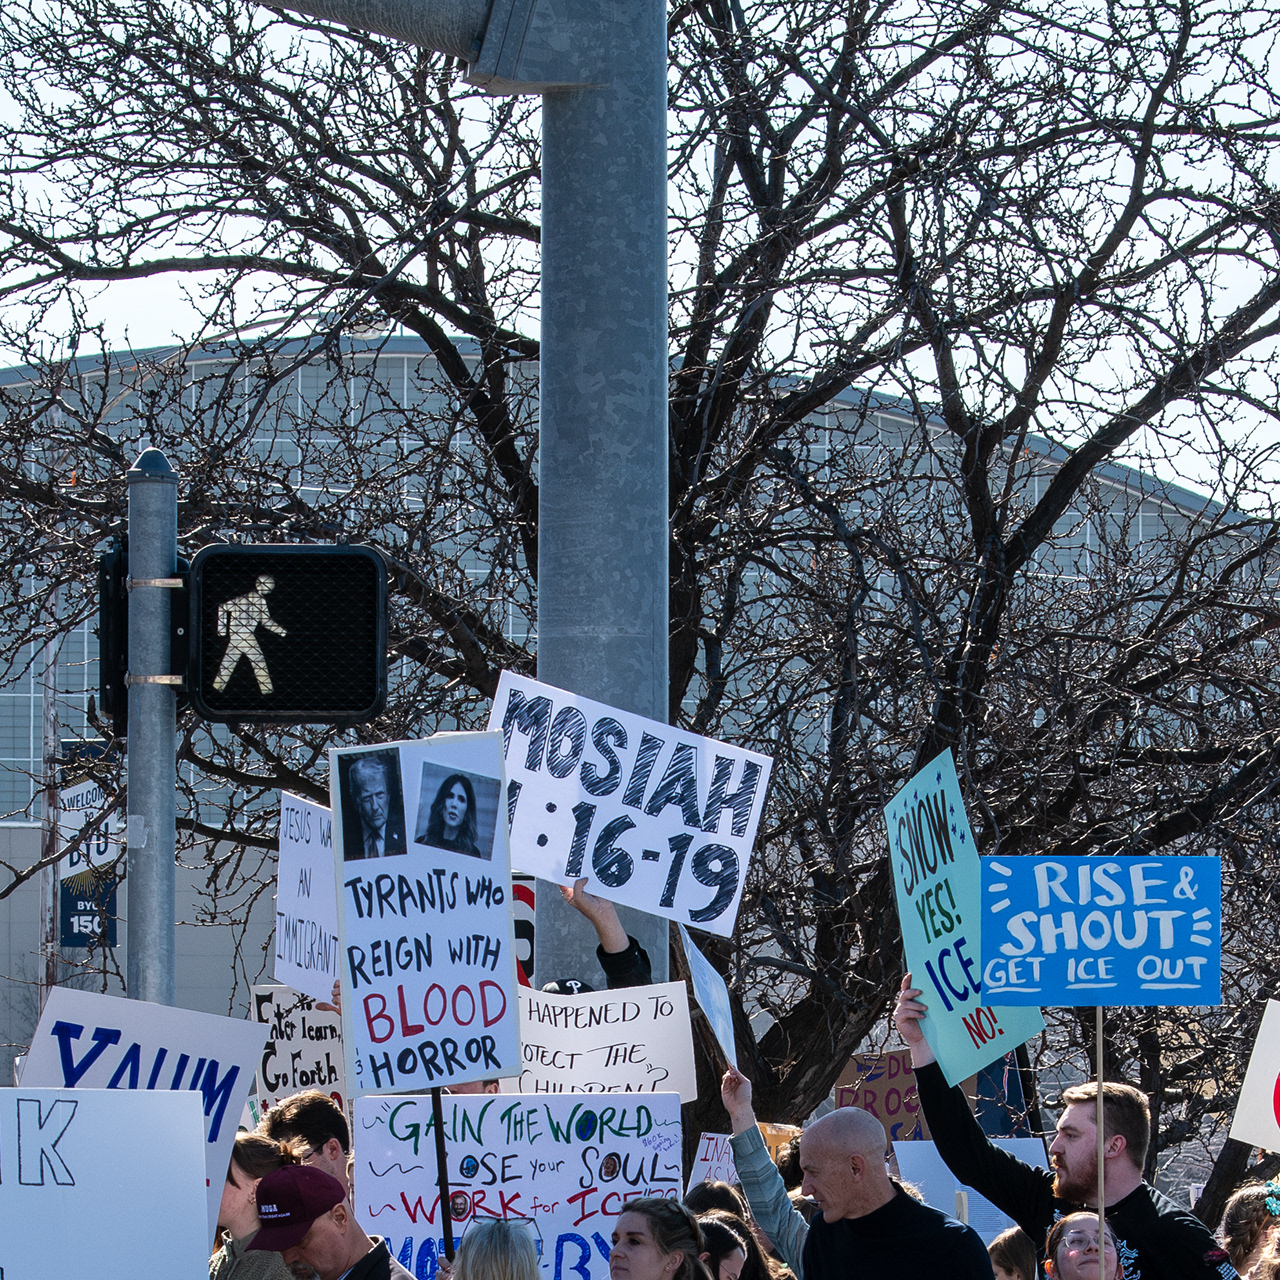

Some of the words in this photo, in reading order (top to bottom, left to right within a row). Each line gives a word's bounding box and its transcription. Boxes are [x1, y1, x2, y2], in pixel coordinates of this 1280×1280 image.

[503, 688, 763, 838] MOSIAH
[284, 806, 311, 845] JESUS
[897, 789, 955, 896] SNOW
[297, 867, 311, 898] AN
[344, 868, 459, 919] TYRANTS
[465, 875, 504, 909] WHO
[1033, 861, 1168, 908] RISE
[1172, 866, 1199, 900] &
[915, 877, 962, 944] YES!
[999, 909, 1187, 956] SHOUT
[276, 911, 338, 977] IMMIGRANT
[347, 933, 432, 989] REIGN
[448, 934, 501, 971] WITH
[924, 936, 981, 1012] ICE
[983, 957, 1046, 988] GET
[1067, 957, 1116, 982] ICE
[1137, 955, 1208, 980] OUT
[255, 994, 296, 1040] Enter
[301, 1016, 342, 1043] learn,
[363, 980, 507, 1044] BLOOD
[528, 998, 641, 1029] HAPPENED
[648, 995, 674, 1020] TO
[962, 1006, 1004, 1050] NO!
[261, 1041, 289, 1093] Go
[290, 1049, 339, 1090] Forth
[369, 1035, 502, 1088] HORROR
[521, 1042, 583, 1070] OTECT
[587, 1043, 647, 1068] THE
[500, 1101, 544, 1147] THE
[543, 1102, 653, 1145] WORLD
[435, 1152, 523, 1188] LOSE
[530, 1159, 565, 1181] your
[579, 1146, 679, 1188] SOUL
[400, 1189, 527, 1226] WORK
[530, 1196, 560, 1218] for
